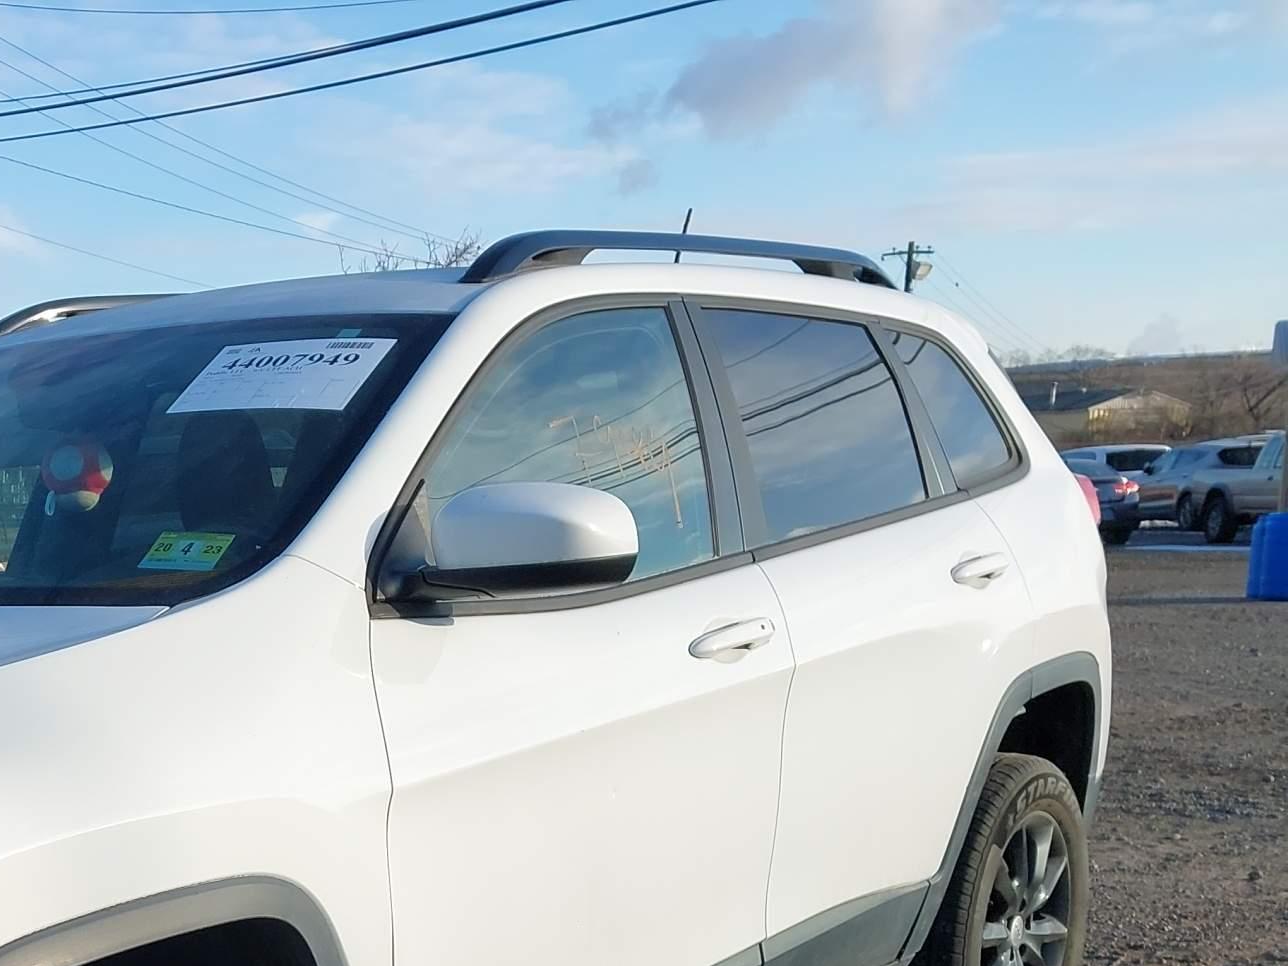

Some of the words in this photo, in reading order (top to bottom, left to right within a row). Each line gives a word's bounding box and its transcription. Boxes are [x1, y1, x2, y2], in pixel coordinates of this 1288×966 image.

[221, 352, 361, 370] 44007949
[154, 542, 172, 552] 20
[181, 542, 195, 555] 4
[203, 545, 223, 554] 23
